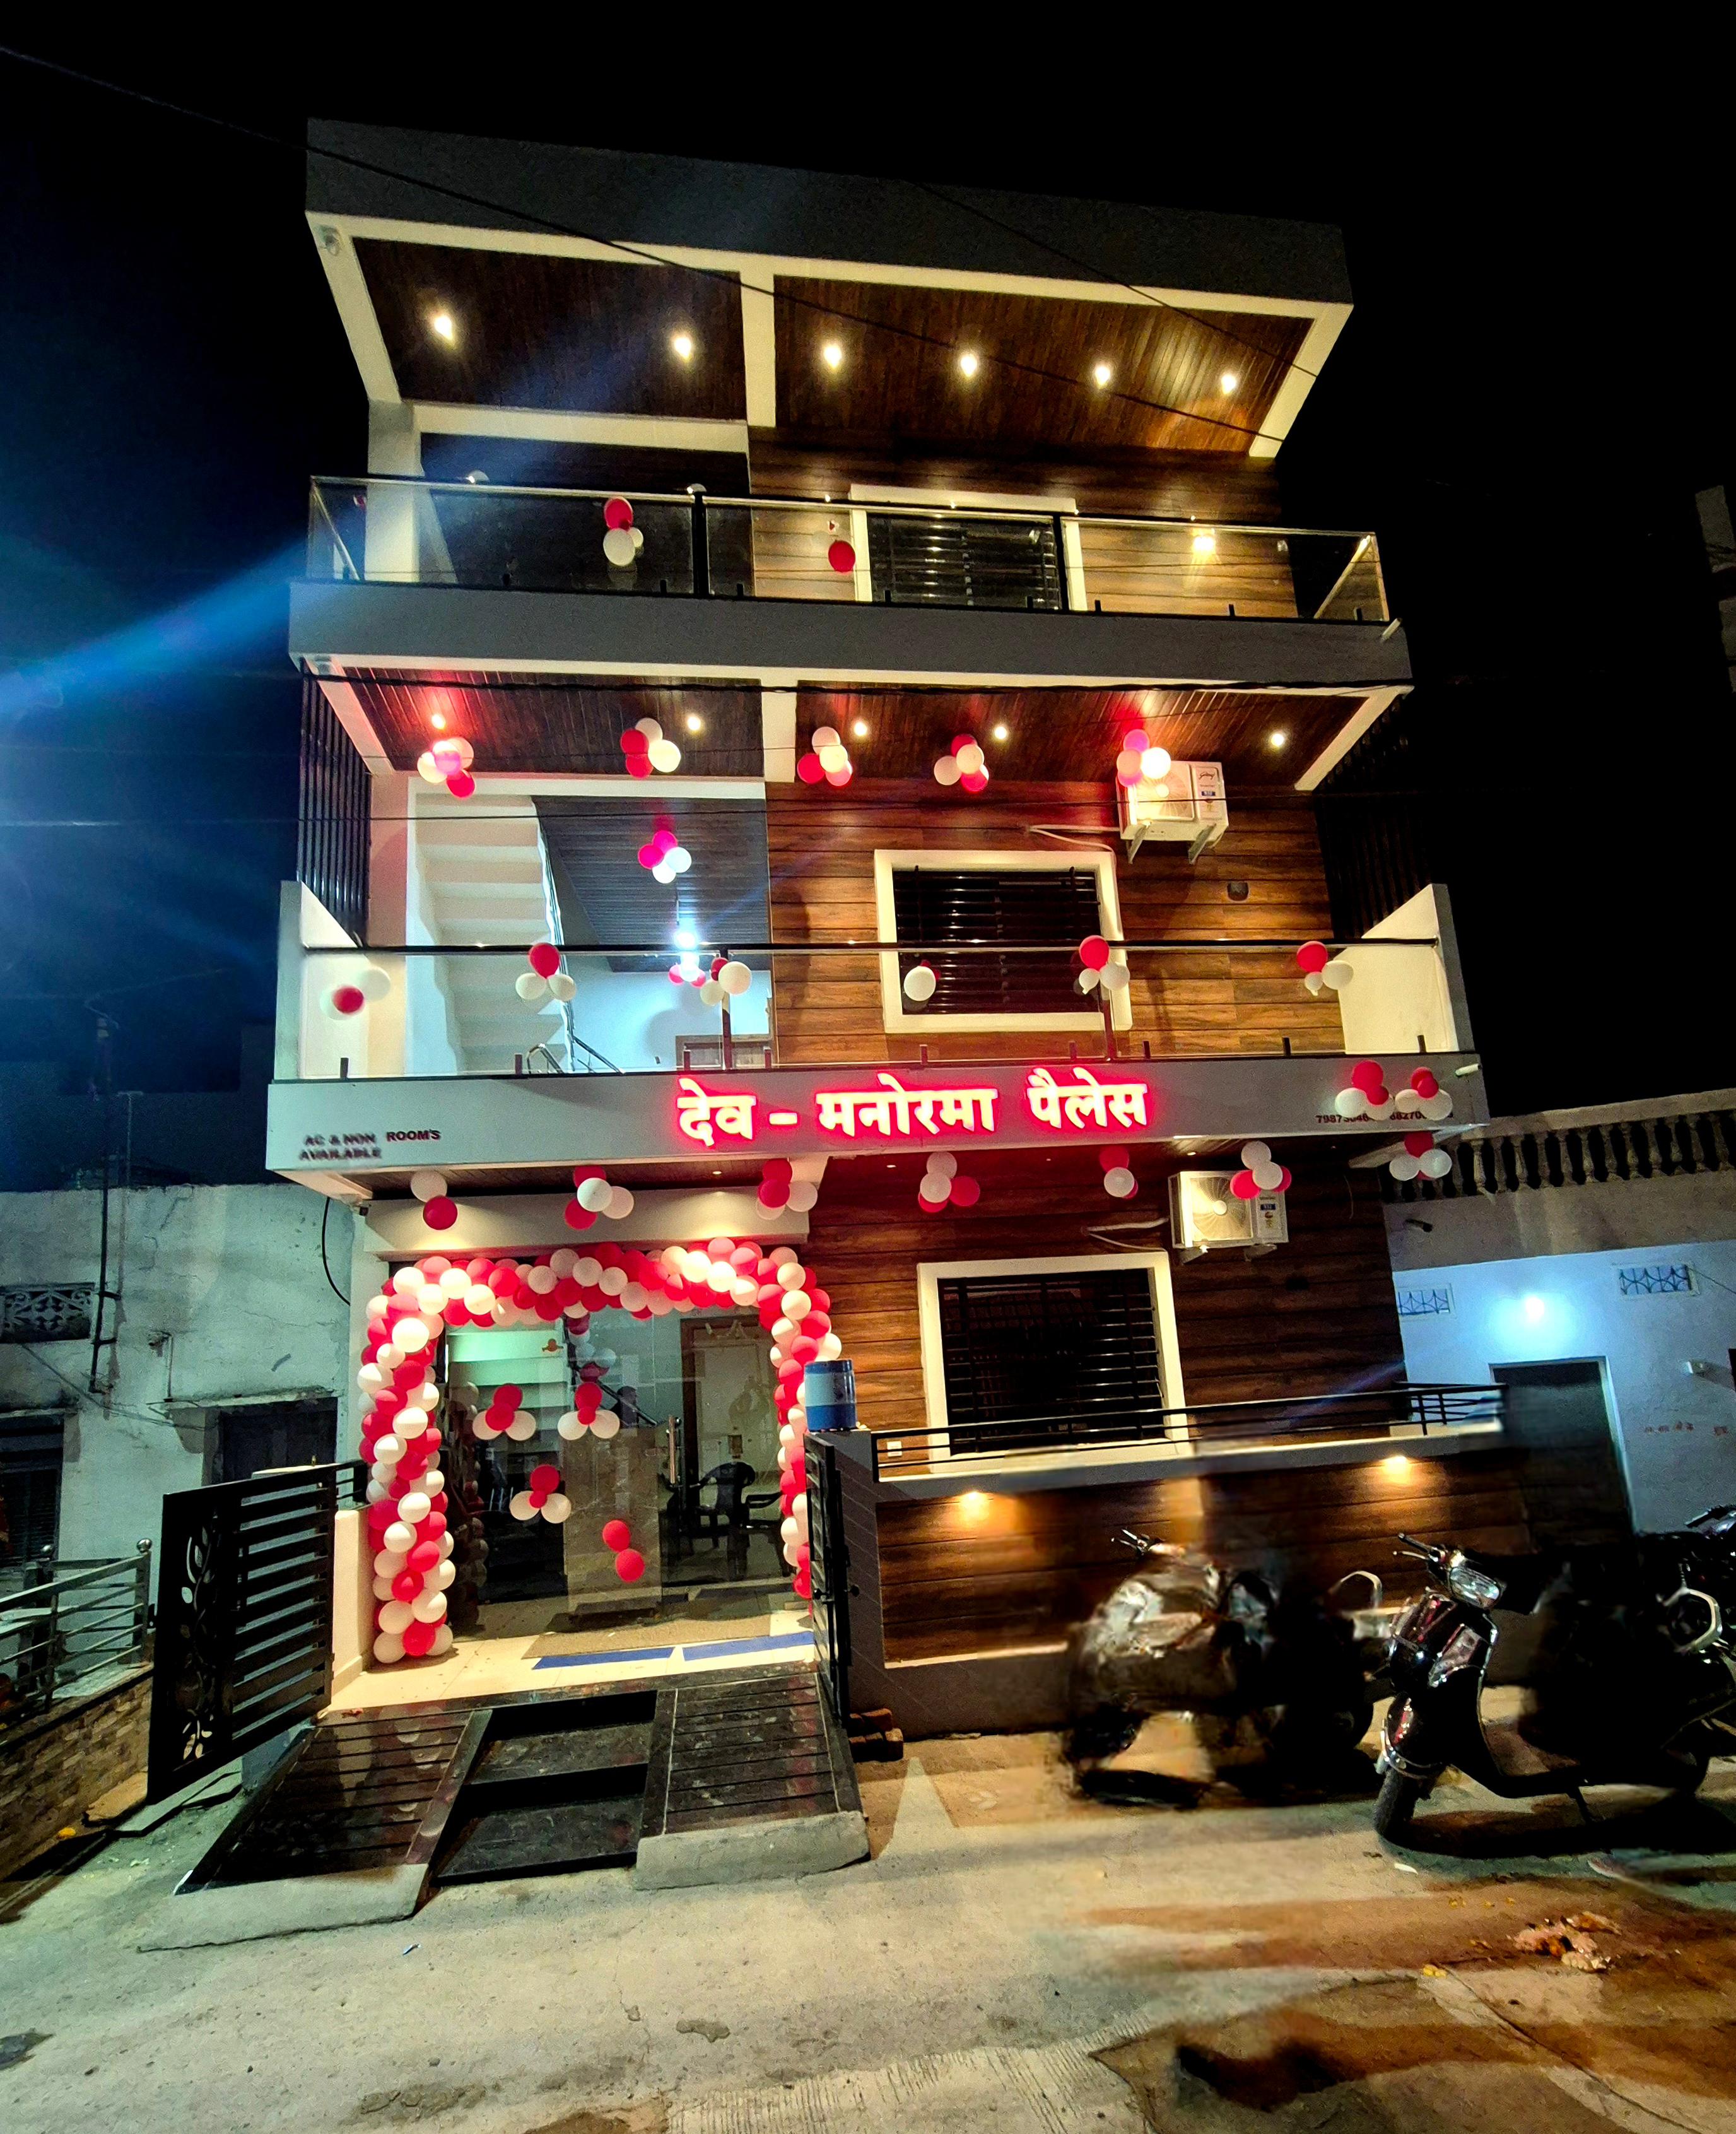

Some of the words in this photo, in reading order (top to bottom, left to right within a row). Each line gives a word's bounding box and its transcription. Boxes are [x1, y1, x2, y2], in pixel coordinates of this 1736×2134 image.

[677, 1078, 757, 1147] देव
[816, 1073, 998, 1136] मनोरमा
[1026, 1067, 1147, 1128] पैलेस
